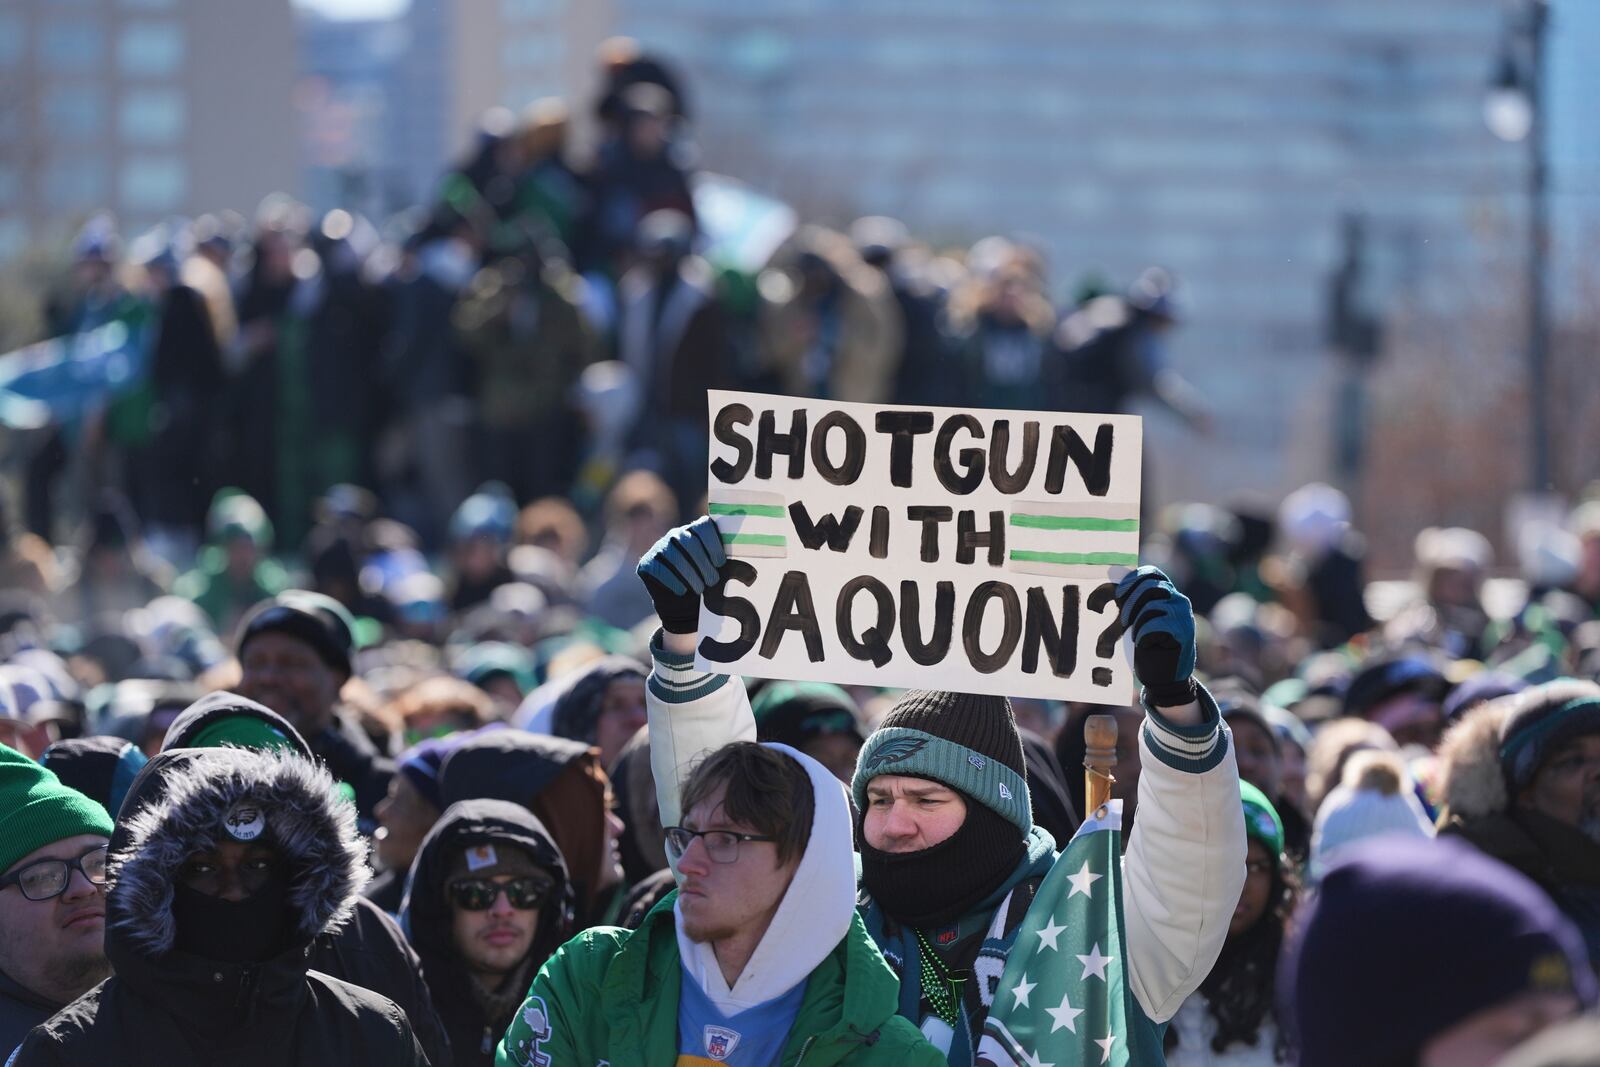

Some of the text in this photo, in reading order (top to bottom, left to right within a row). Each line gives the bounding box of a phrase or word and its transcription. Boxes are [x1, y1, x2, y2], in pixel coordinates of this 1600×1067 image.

[709, 402, 1114, 497] SHOTGUN
[787, 500, 1005, 567] WITH
[698, 559, 1126, 688] SAQUON?
[937, 930, 956, 944] NFL
